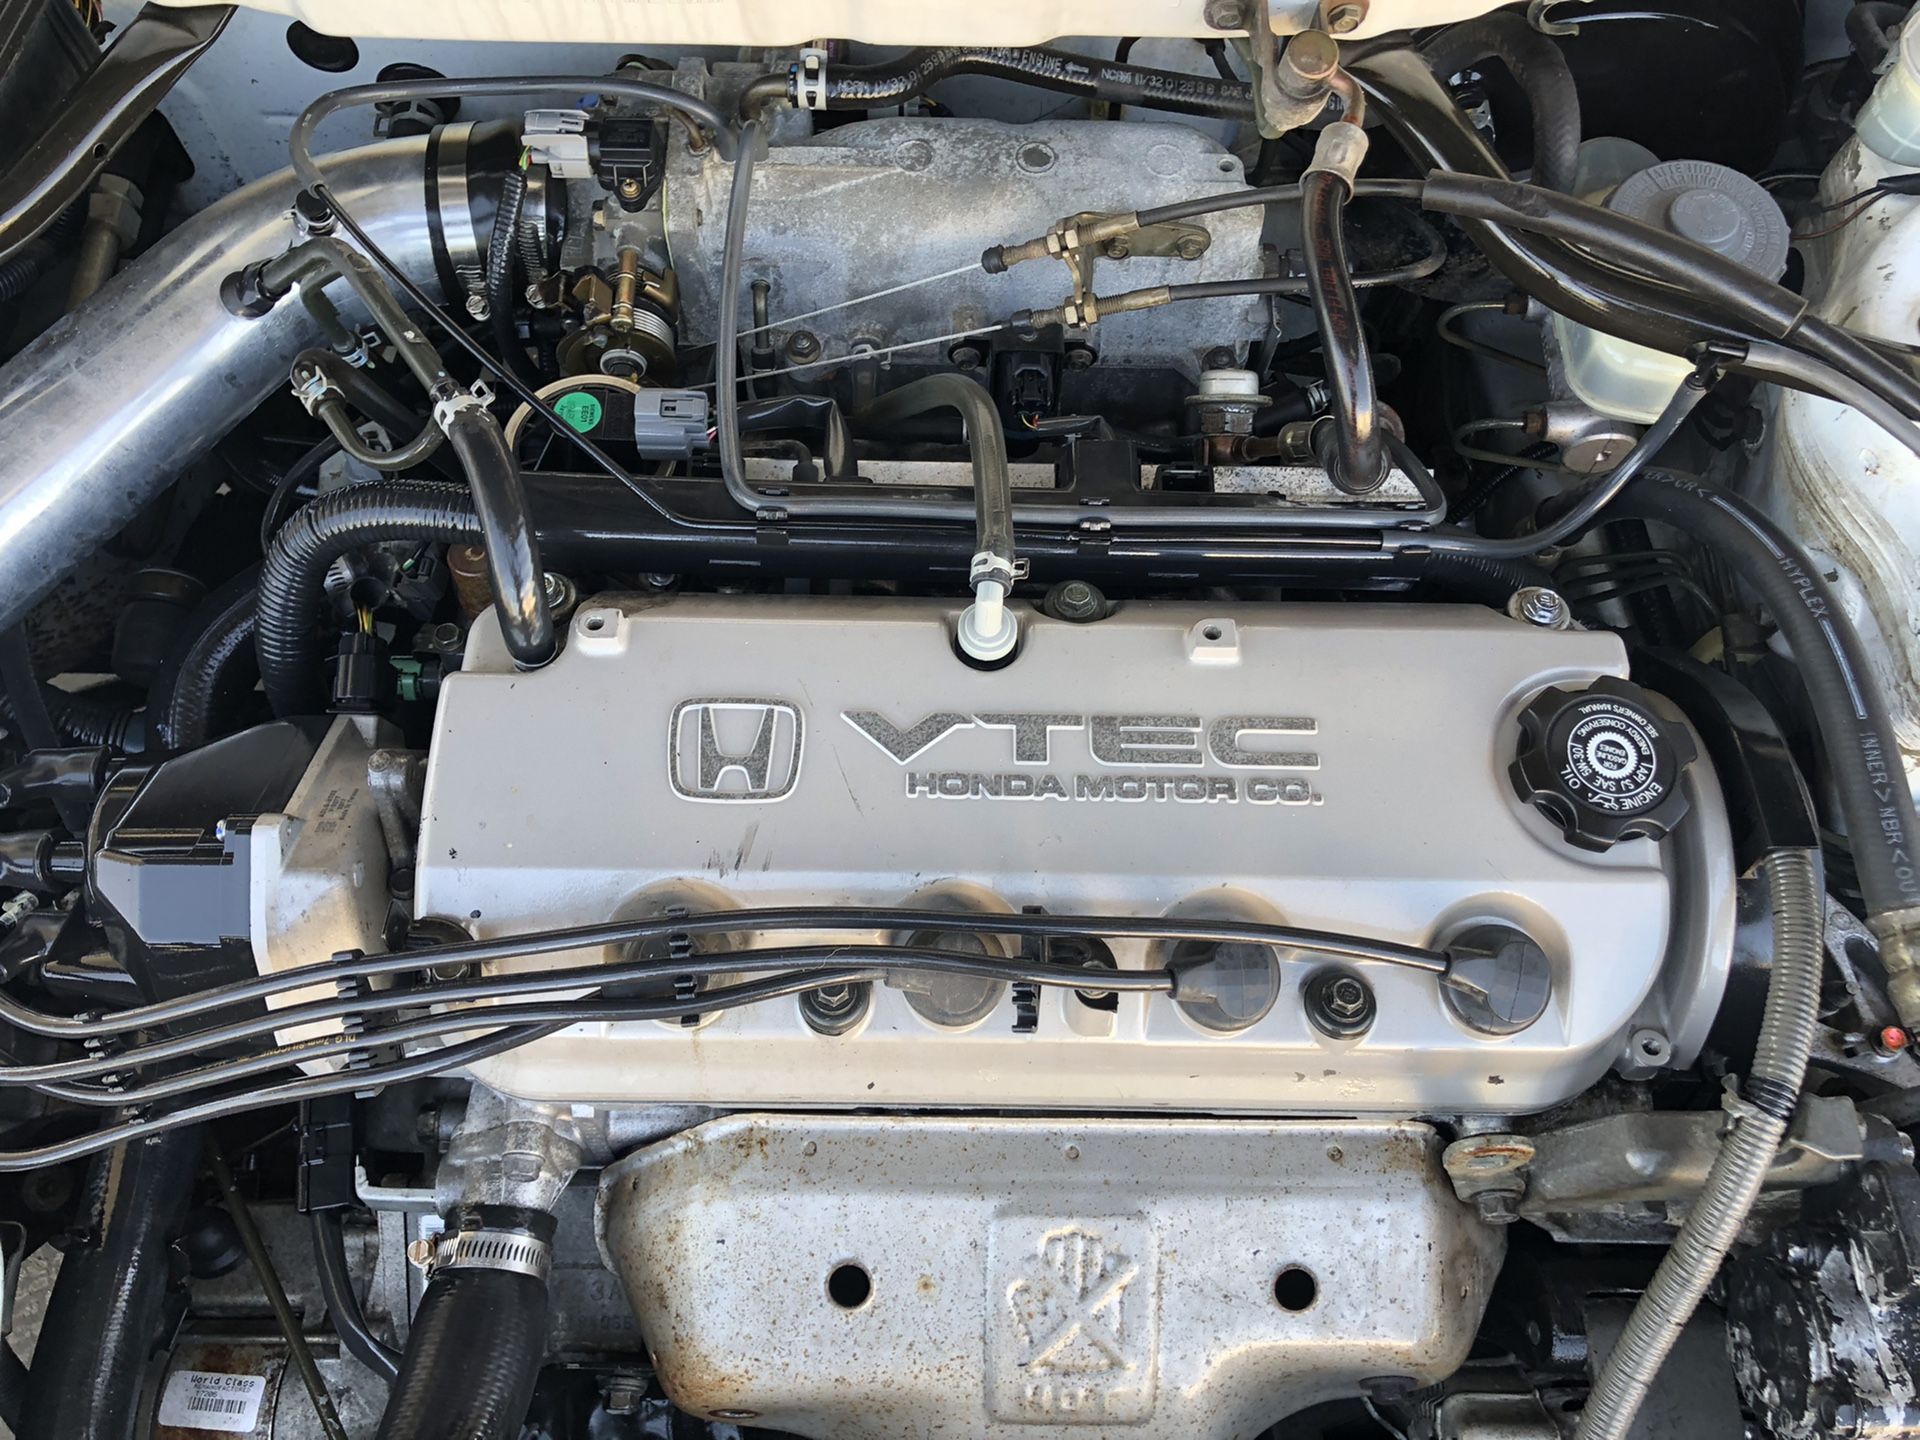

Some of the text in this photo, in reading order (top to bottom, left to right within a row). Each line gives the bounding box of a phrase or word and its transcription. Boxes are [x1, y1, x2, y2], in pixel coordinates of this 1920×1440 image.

[1020, 50, 1063, 71] ENGINE
[1778, 557, 1829, 619] HYPLEX
[1577, 718, 1650, 756] ENERGY CONSERVING
[1578, 702, 1660, 739] SEE OWNER'S MANUAL
[839, 710, 1322, 770] VTEC
[1594, 750, 1628, 766] GASOLINE
[1599, 743, 1627, 756] ENGINES
[1571, 747, 1649, 792] API SJ SAE 5W-30
[1603, 761, 1618, 770] FOR
[905, 771, 1325, 807] HONDA MOTOR CO.
[1560, 764, 1664, 811] ENGINE OIL
[190, 1374, 255, 1387] World Class
